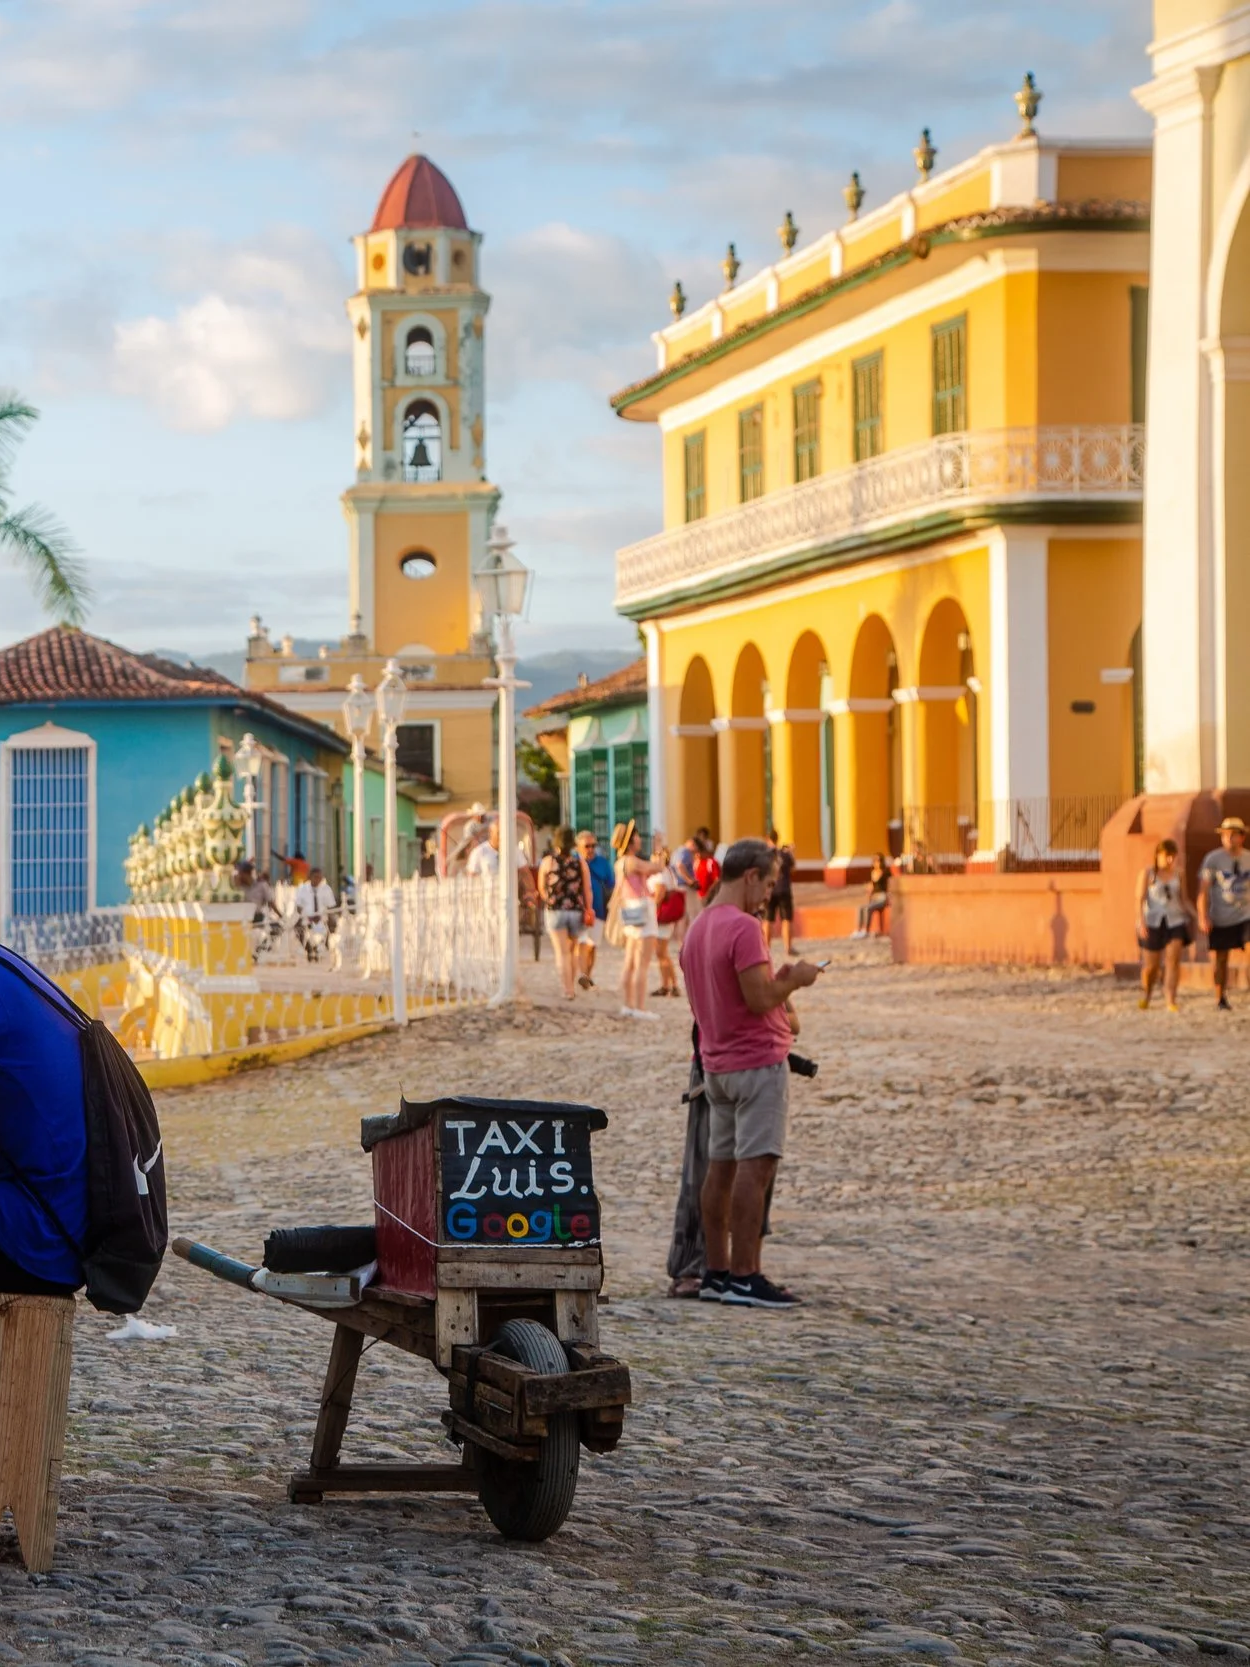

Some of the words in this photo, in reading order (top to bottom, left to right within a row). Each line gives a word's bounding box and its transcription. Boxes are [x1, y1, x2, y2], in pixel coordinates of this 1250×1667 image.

[445, 1120, 566, 1156] TAXI
[450, 1156, 589, 1200] Luis.
[446, 1203, 592, 1243] Google
